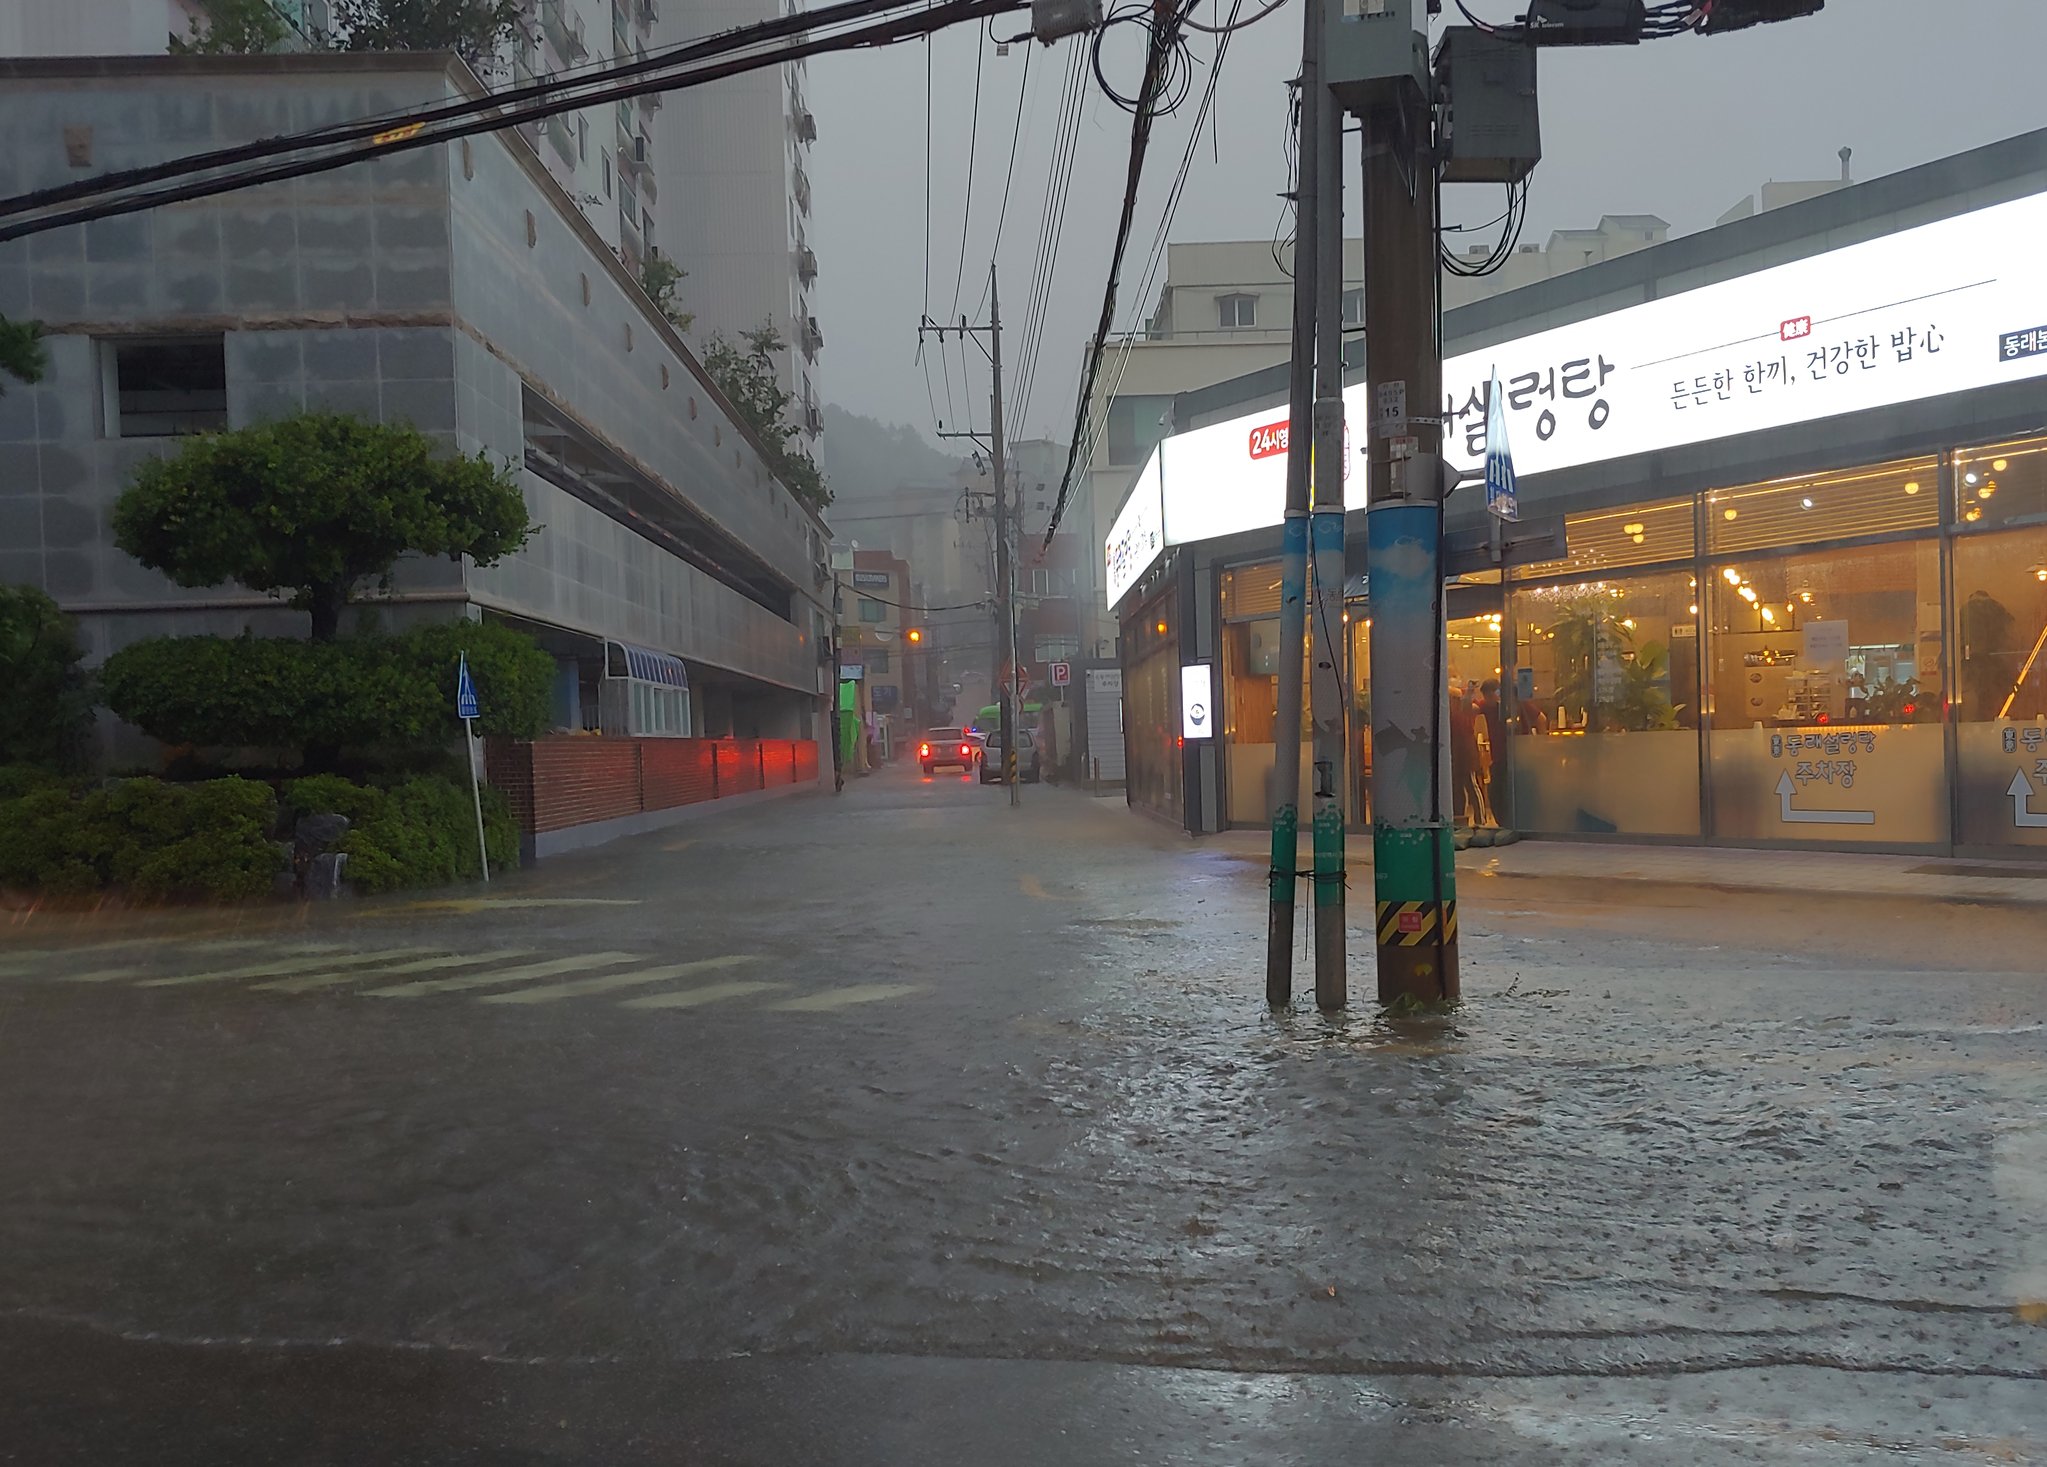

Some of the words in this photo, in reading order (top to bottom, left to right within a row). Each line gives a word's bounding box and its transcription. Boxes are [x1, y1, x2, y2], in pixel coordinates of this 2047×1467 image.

[1669, 368, 1734, 411] 든든한
[1743, 356, 1796, 395] 한끼,
[1806, 335, 1880, 381] 건강한
[1385, 406, 1399, 417] 15
[1442, 354, 1616, 457] 설렁탕
[1251, 427, 1289, 455] 24시영
[1055, 665, 1066, 681] P
[2019, 727, 2047, 752] 동
[1795, 760, 1856, 788] 주차장
